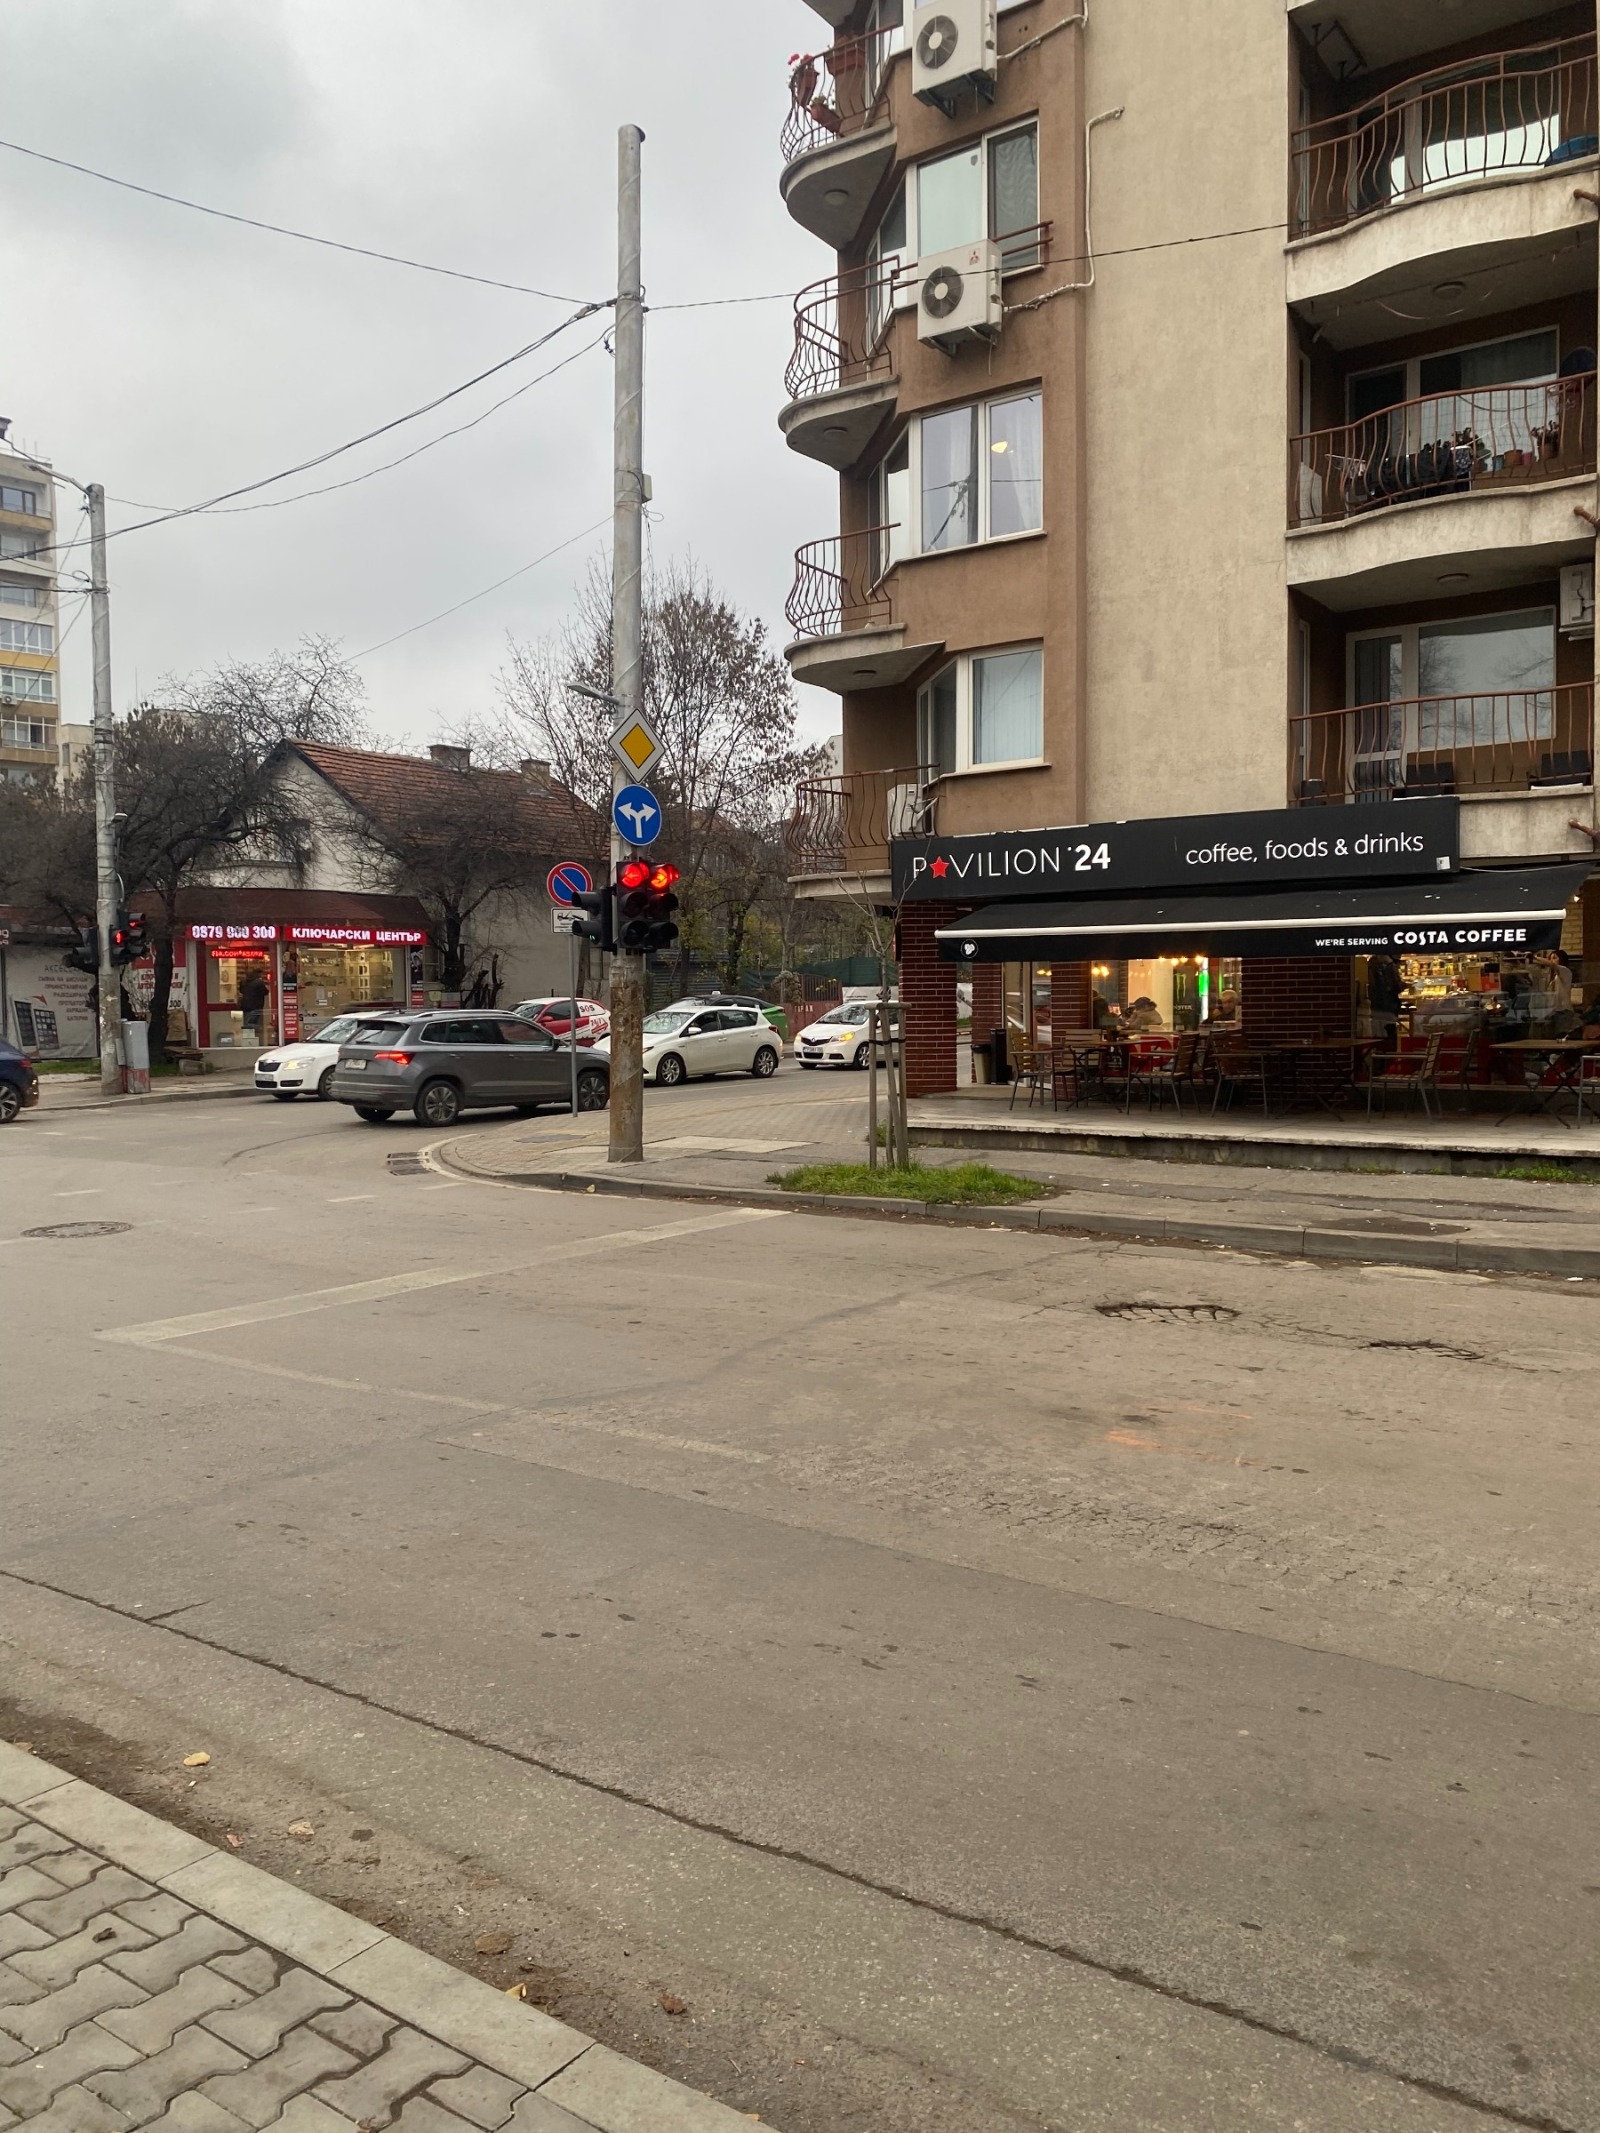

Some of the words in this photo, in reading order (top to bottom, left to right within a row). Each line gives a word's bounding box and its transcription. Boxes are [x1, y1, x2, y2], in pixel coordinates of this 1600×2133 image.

[1186, 843, 1258, 865] coffee,
[1265, 837, 1328, 860] foods
[1334, 838, 1349, 856] &
[1354, 832, 1424, 855] drinks
[252, 925, 276, 939] 300
[292, 927, 370, 940] КЛЮЧАРСКИ
[376, 931, 422, 942] ЦЕНТЪР
[1315, 938, 1345, 947] WE'RE
[1347, 937, 1389, 946] SERVING
[1393, 930, 1449, 946] COSTA
[1455, 928, 1527, 943] COFFEE
